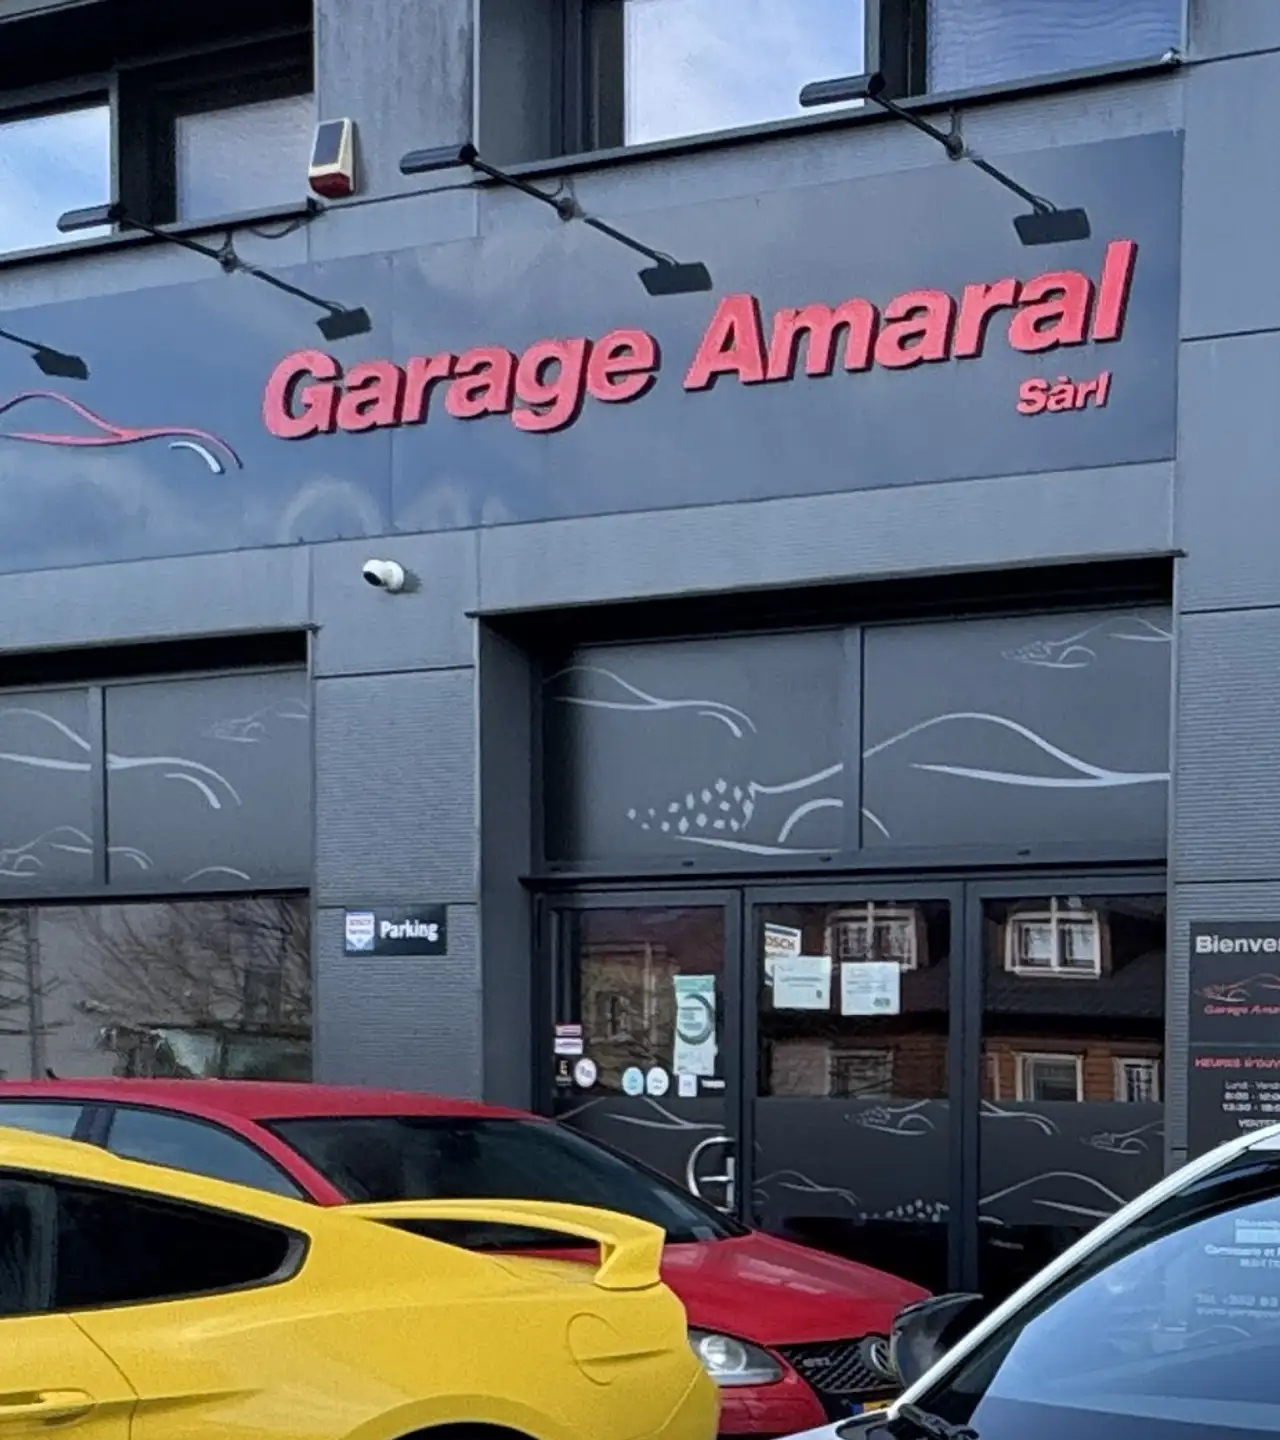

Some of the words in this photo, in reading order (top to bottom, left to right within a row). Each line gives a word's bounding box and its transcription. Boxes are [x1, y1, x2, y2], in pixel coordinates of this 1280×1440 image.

[262, 328, 661, 440] Garage
[682, 238, 1138, 391] Amaral
[1016, 371, 1112, 415] Sàrl
[380, 919, 439, 943] Parking
